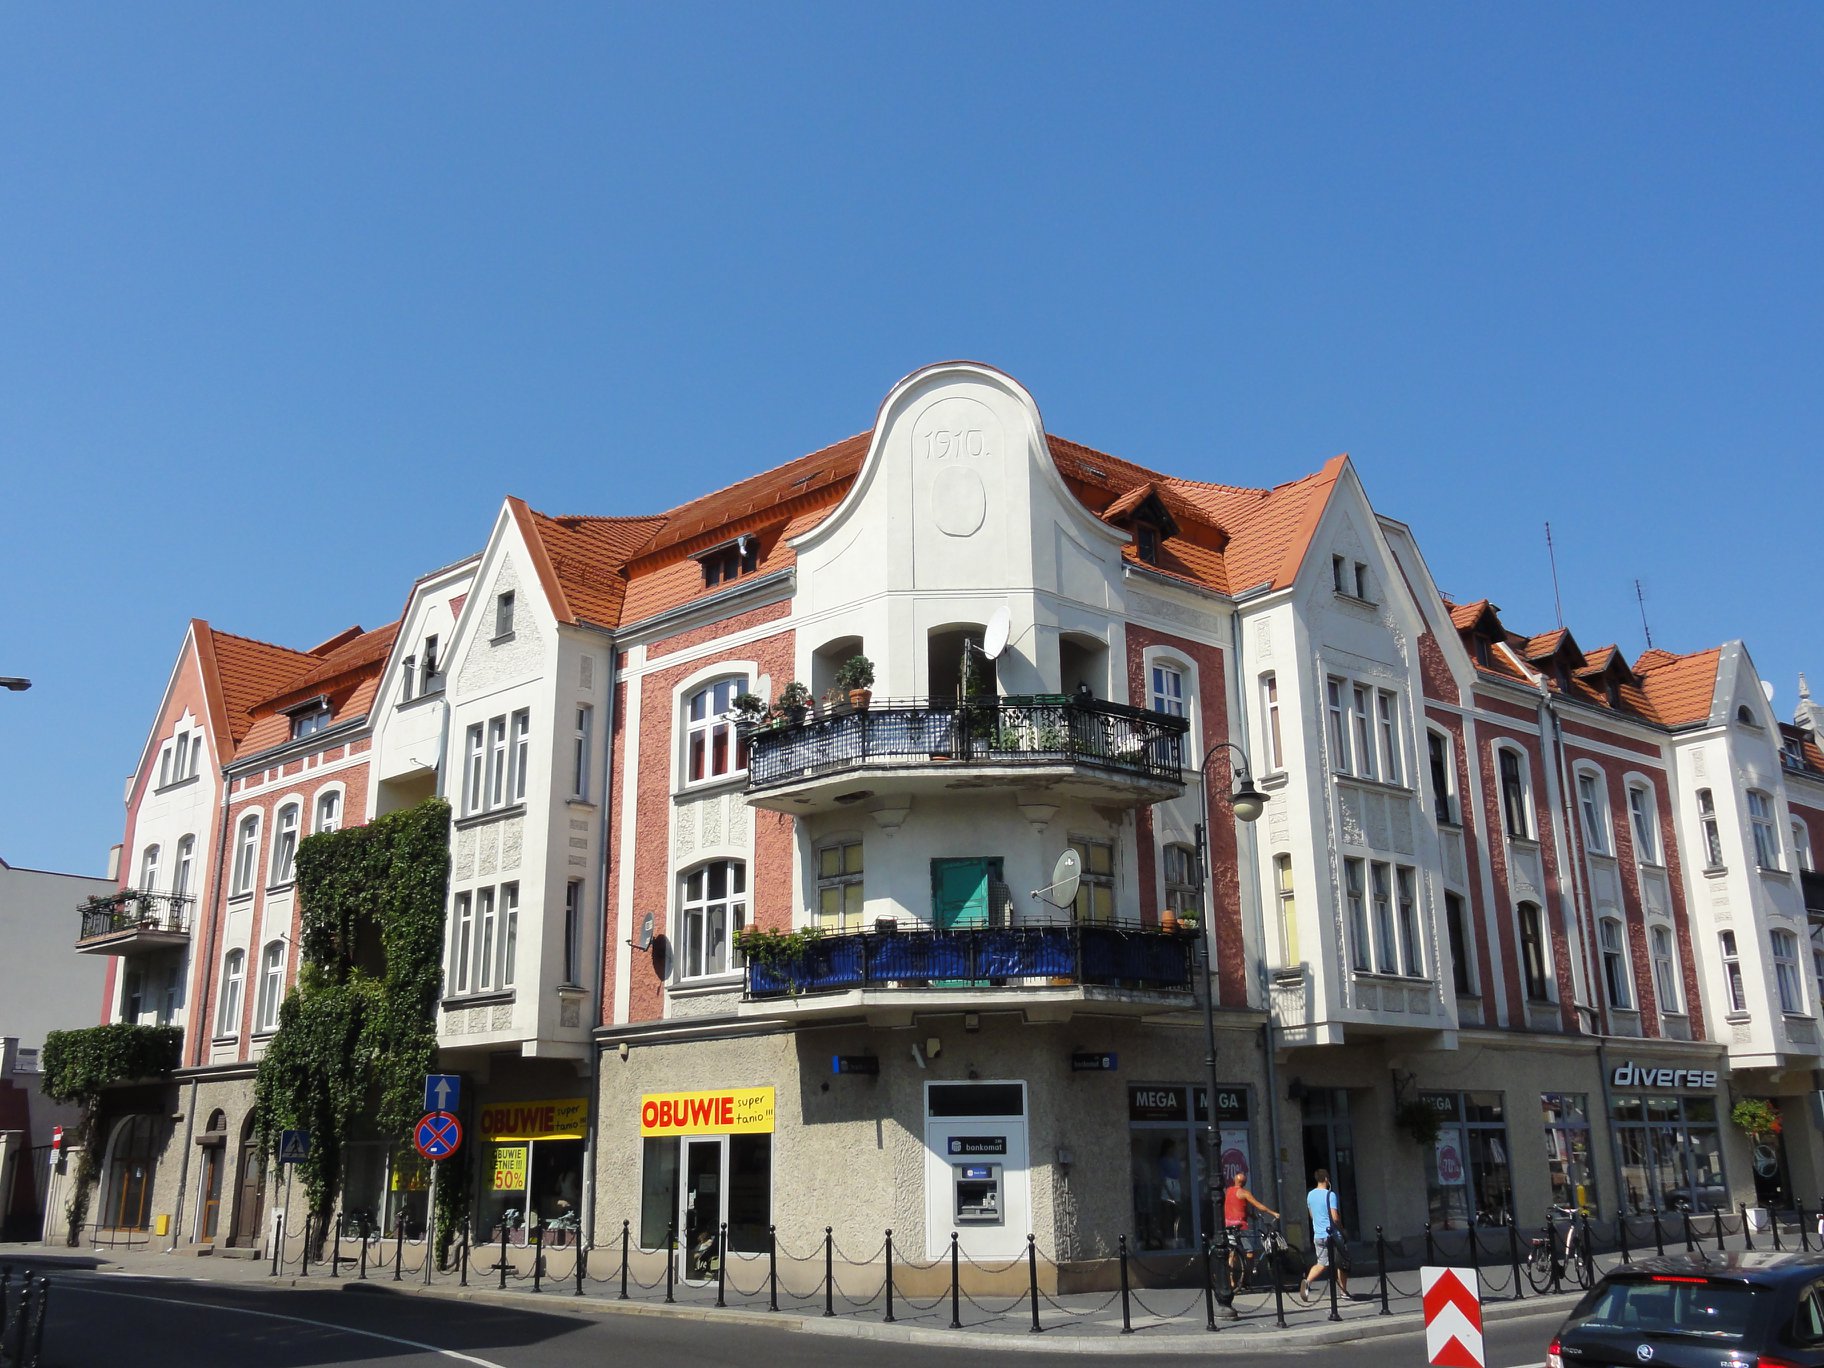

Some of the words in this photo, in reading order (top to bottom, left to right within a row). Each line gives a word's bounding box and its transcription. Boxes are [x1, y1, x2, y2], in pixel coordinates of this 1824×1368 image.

[1614, 1061, 1718, 1088] diverse
[1136, 1091, 1178, 1108] MEGA
[1200, 1093, 1239, 1109] MGA
[481, 1105, 555, 1135] OBUWIE
[557, 1105, 580, 1117] super
[642, 1096, 734, 1129] OBUWIE
[737, 1095, 765, 1109] super
[492, 1149, 522, 1160] OBUWIE
[965, 1143, 1003, 1151] bankomat
